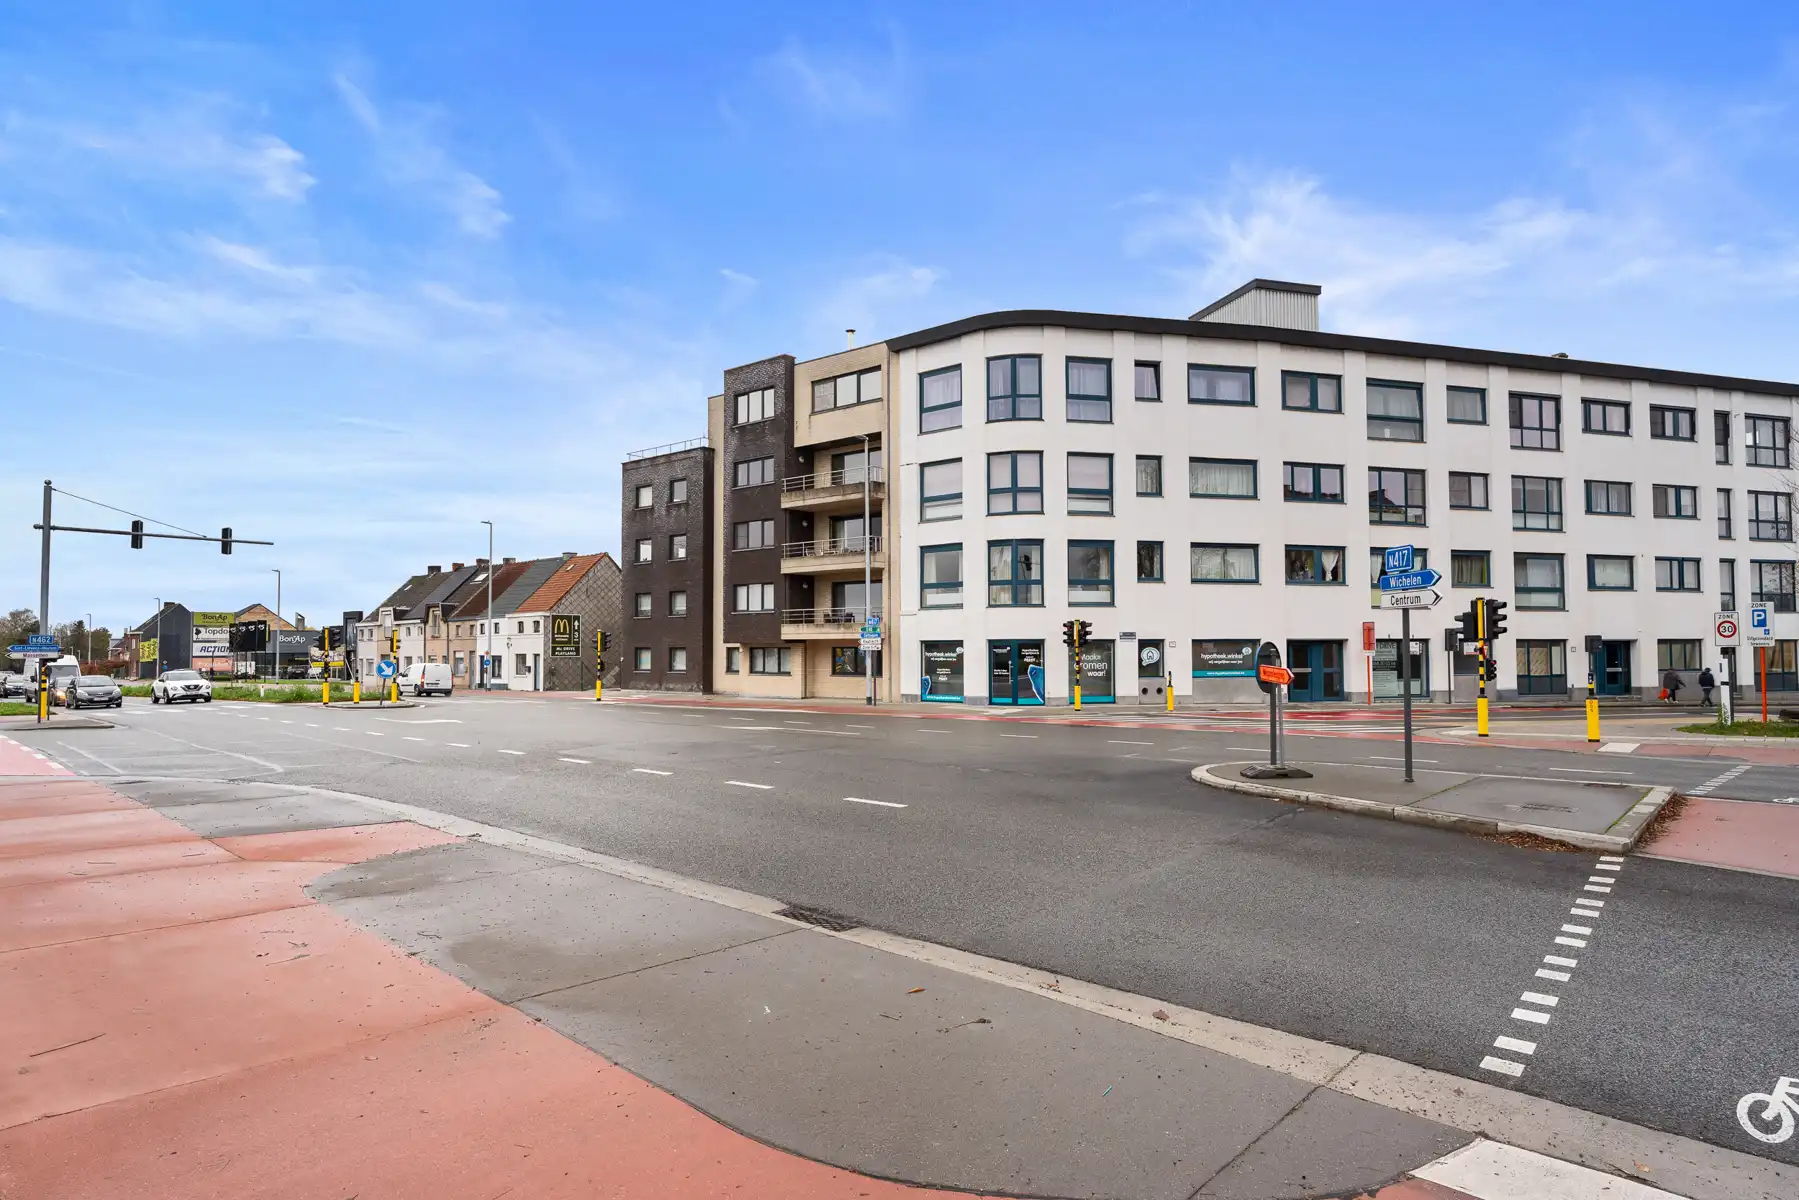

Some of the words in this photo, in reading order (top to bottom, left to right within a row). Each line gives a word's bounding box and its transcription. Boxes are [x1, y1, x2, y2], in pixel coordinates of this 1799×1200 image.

[1389, 550, 1407, 568] N417
[1389, 575, 1421, 587] Wichelen
[1390, 595, 1421, 605] Centrum
[1754, 612, 1765, 626] P
